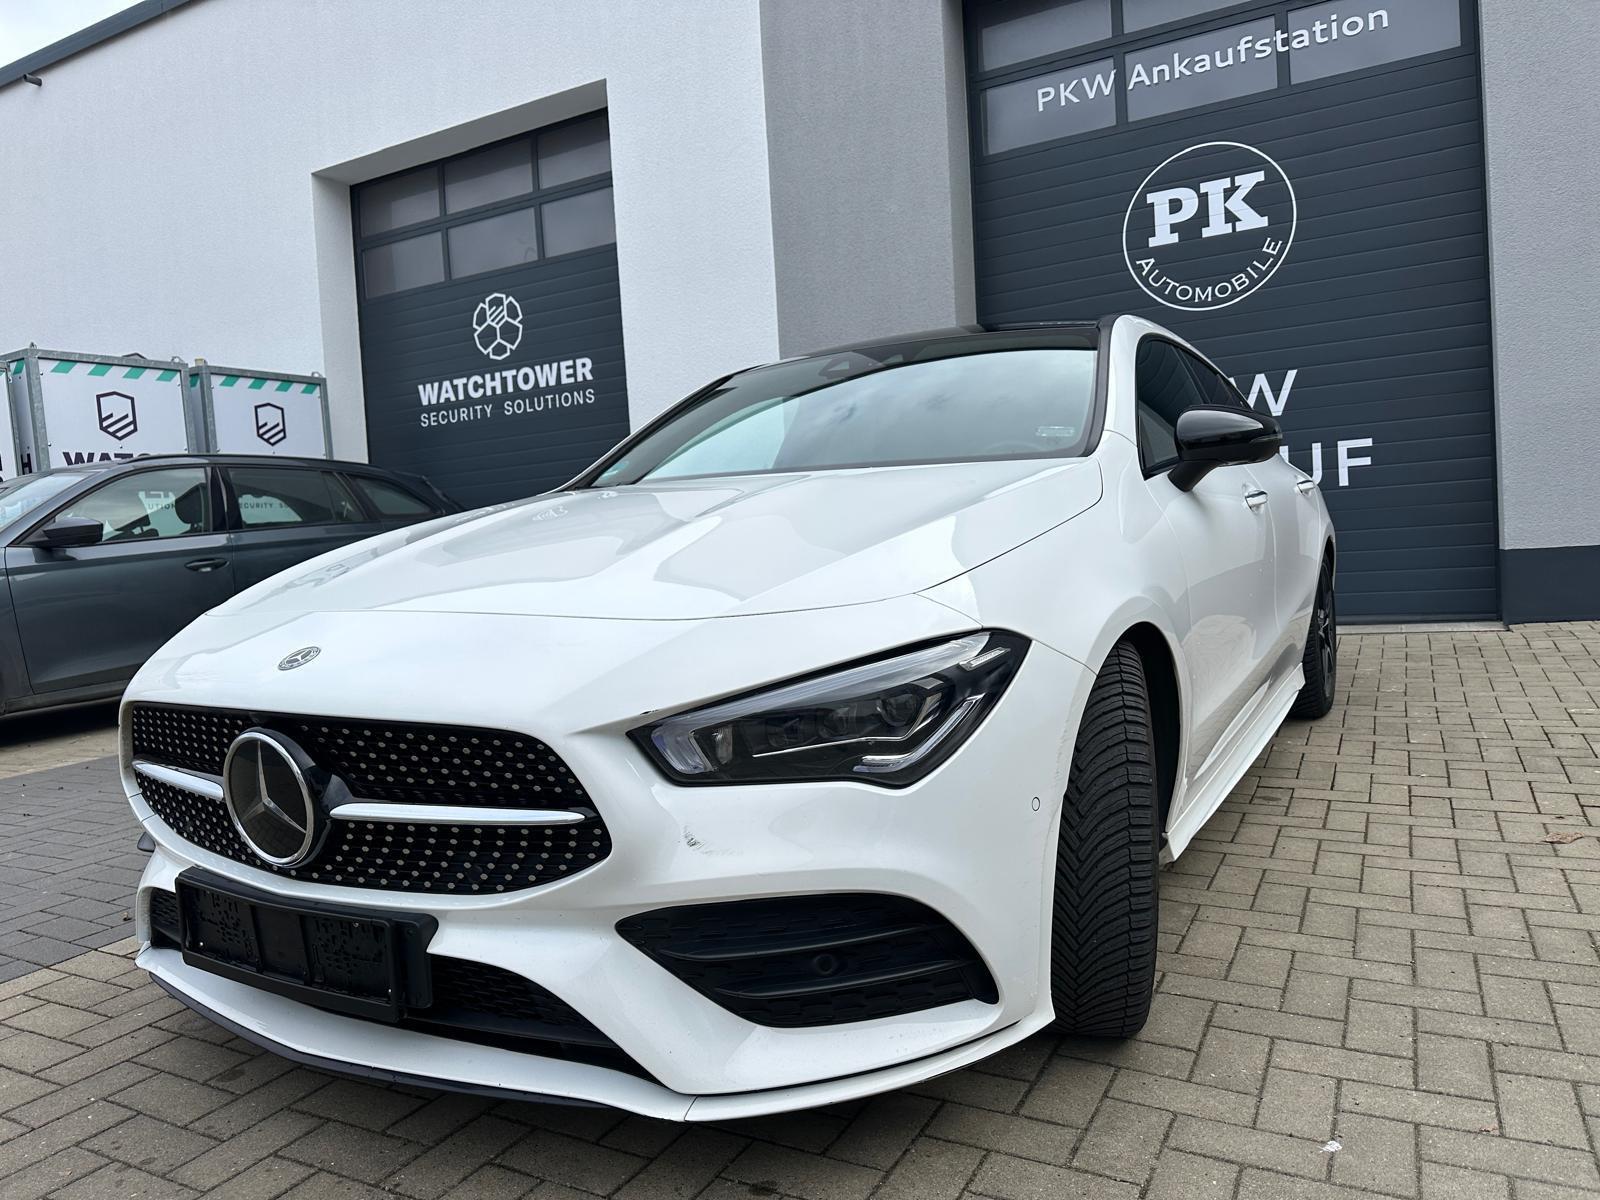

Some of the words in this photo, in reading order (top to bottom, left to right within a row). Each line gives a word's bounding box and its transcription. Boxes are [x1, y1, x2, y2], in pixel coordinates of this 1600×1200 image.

[1036, 69, 1117, 112] PKW
[1127, 8, 1390, 90] Ankaufstation
[1146, 170, 1269, 248] PK
[1135, 237, 1283, 302] AUTOMOBILE
[418, 357, 594, 406] WATCHTOWER
[1228, 369, 1298, 417] W
[420, 403, 493, 428] SECURITY
[504, 388, 596, 416] SOLUTIONS
[1279, 437, 1373, 487] UF
